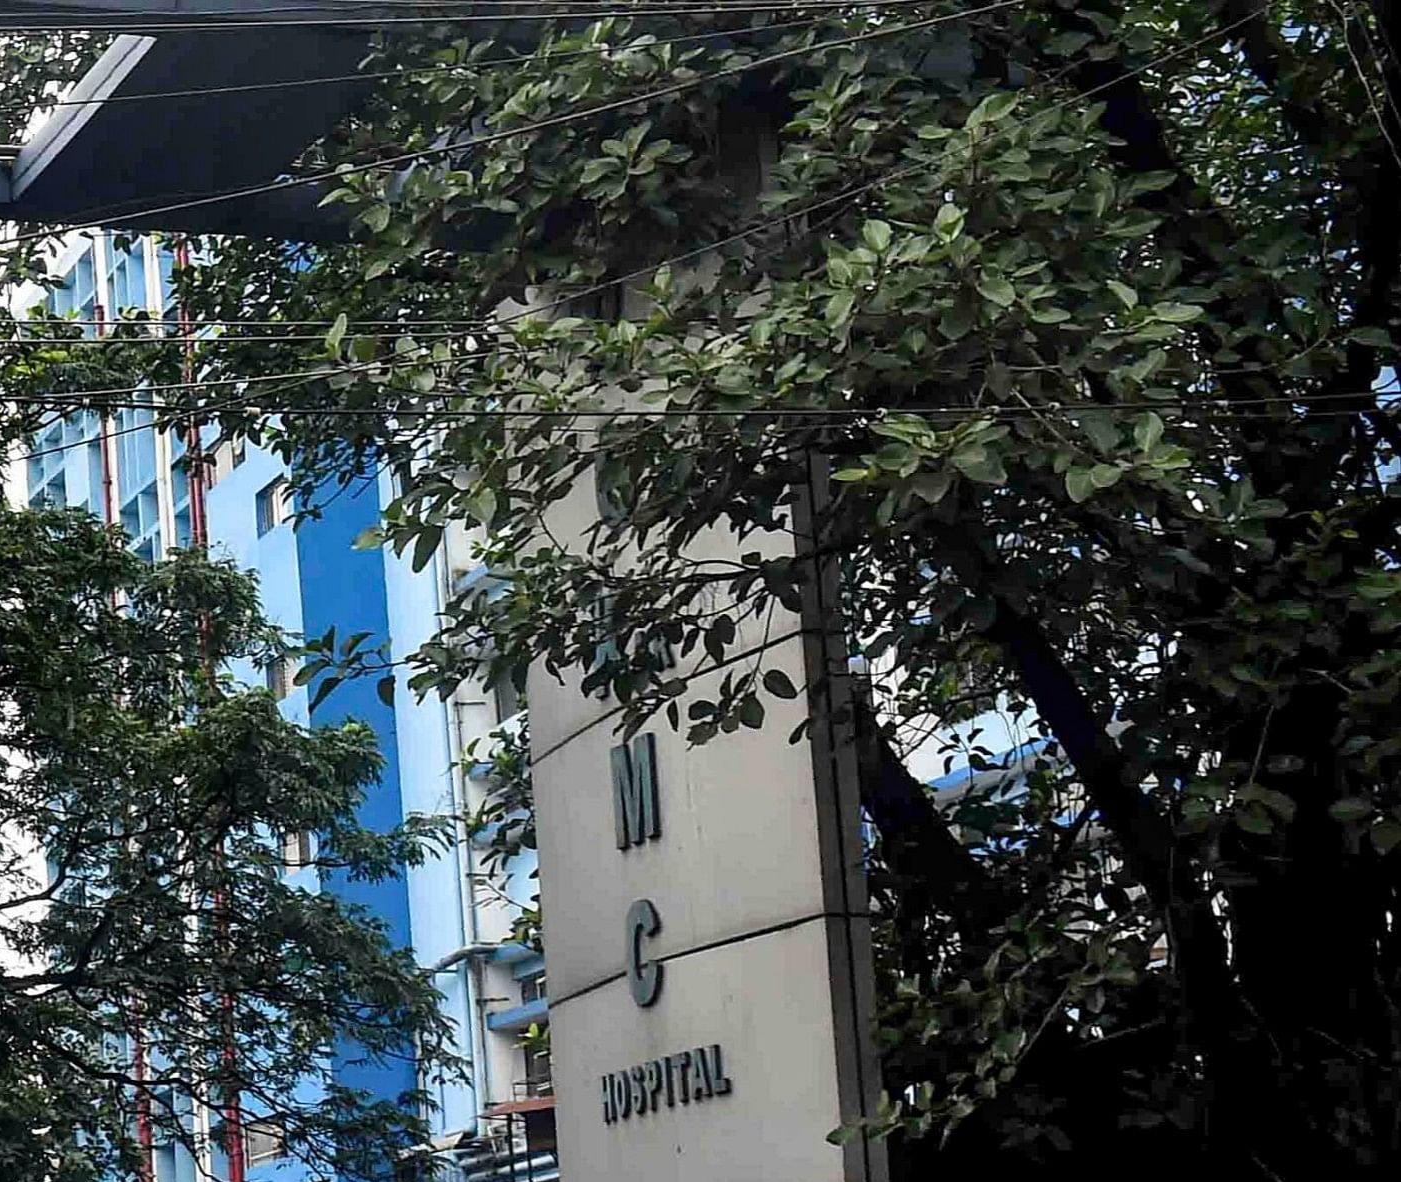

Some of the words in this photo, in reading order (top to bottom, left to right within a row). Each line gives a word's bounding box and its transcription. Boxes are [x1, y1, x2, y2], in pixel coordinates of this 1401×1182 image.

[610, 733, 661, 851] M
[626, 898, 665, 1007] C
[602, 1044, 732, 1126] HOSPITAL
